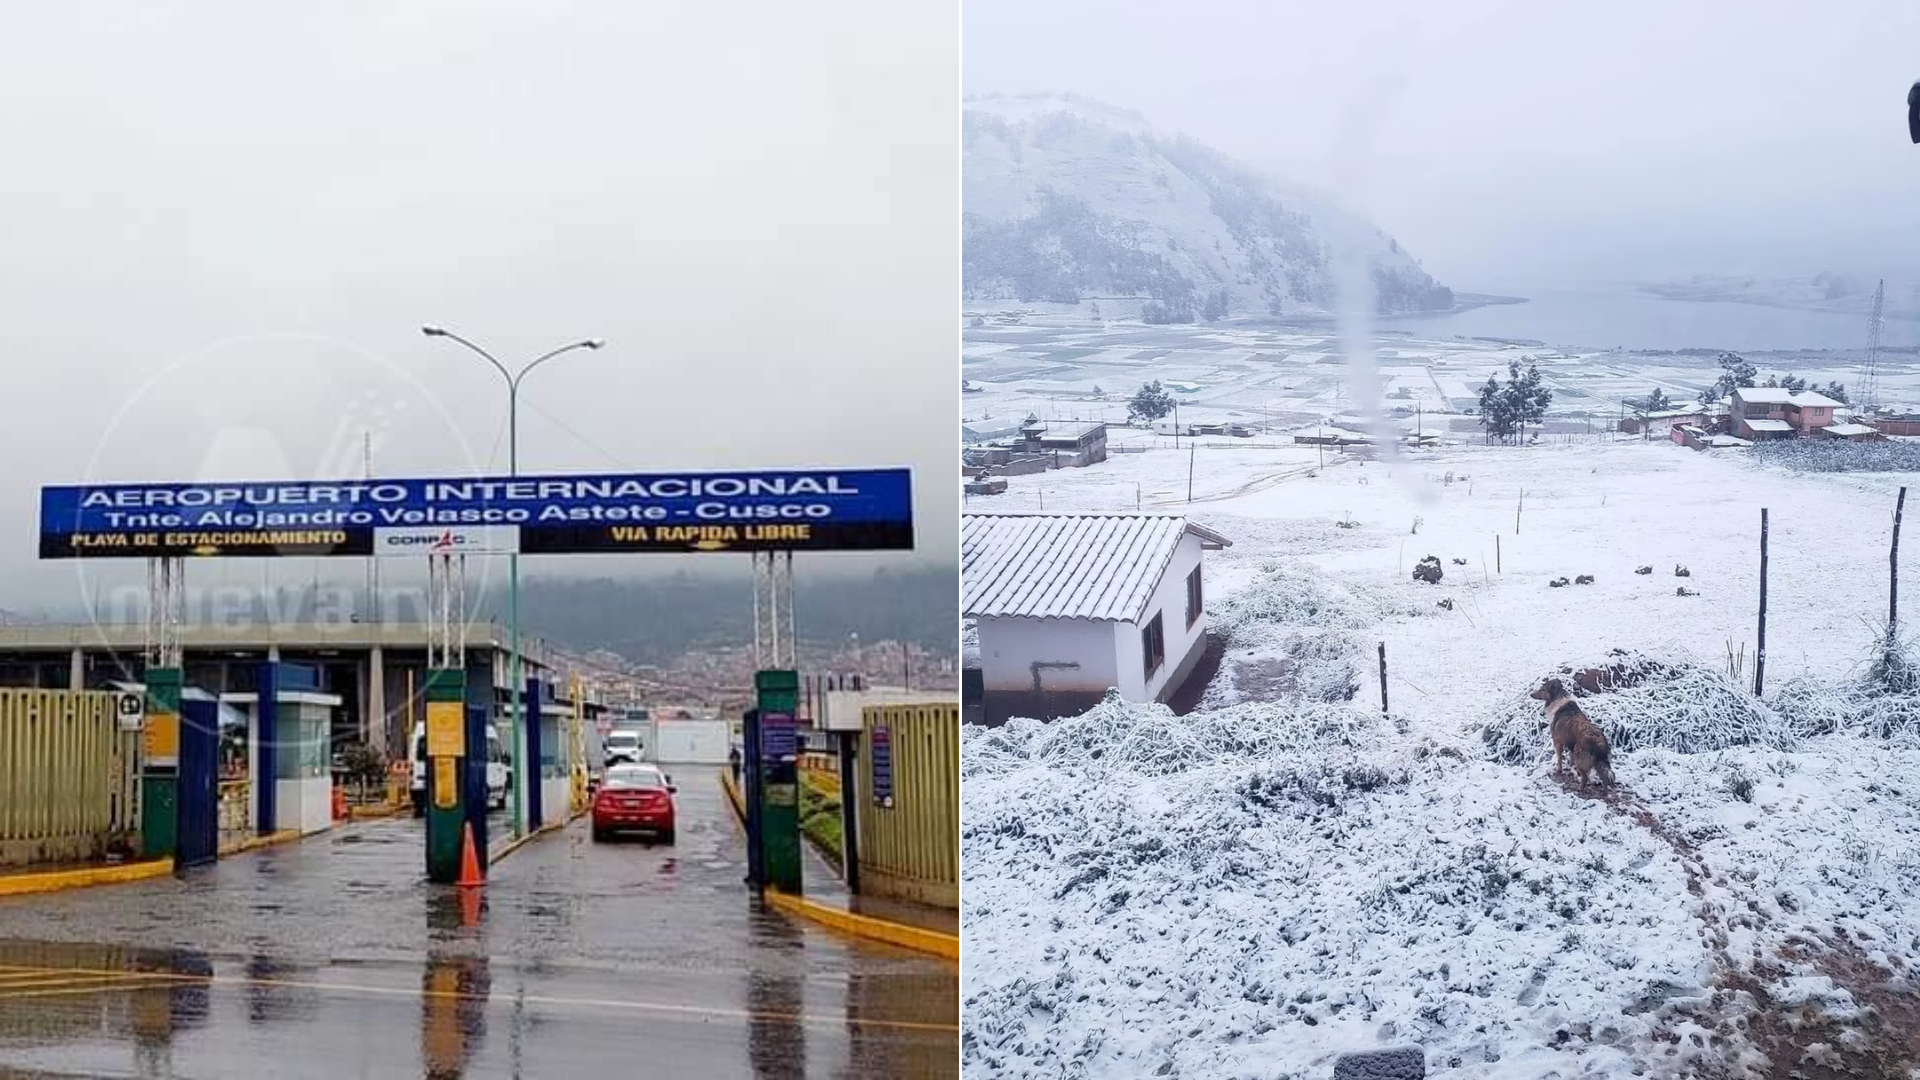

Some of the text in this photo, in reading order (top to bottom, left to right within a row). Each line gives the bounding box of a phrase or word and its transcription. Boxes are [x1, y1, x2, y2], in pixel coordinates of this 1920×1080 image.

[82, 477, 858, 508] AEROPUERTO INTERNACIONAL
[105, 512, 190, 528] Tnte.
[197, 509, 372, 529] Alejandro
[378, 508, 530, 524] Velasco
[538, 503, 666, 521] Astete
[71, 531, 347, 547] PLAYA DE ESTACIONAMIENTO
[612, 525, 811, 541] VIA RAPIDA LIBRE
